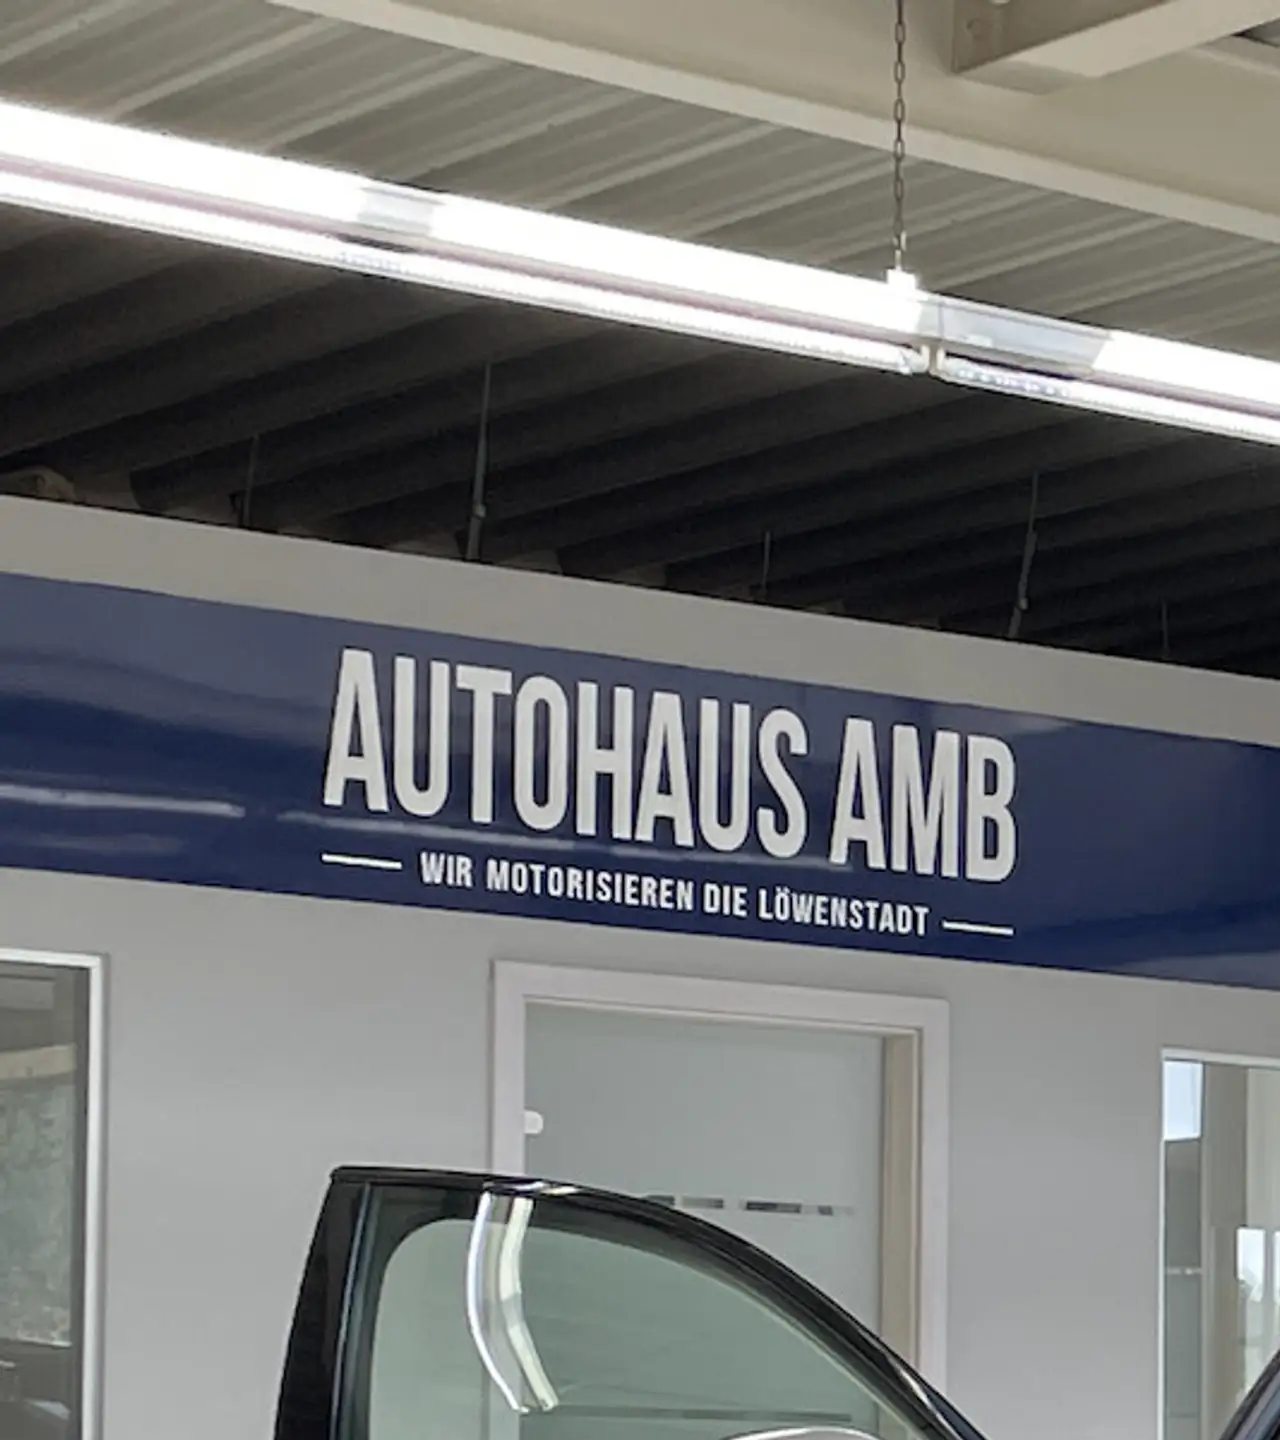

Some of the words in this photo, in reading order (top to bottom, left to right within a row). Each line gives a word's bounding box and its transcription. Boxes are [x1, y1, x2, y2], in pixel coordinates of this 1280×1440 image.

[323, 647, 808, 859] AUTOHAUS
[828, 716, 1017, 883] AMB
[420, 850, 472, 889] WIR
[486, 860, 694, 912] MOTORISIEREN
[703, 881, 749, 917] DIE
[758, 887, 929, 936] LÖWENSTADT
